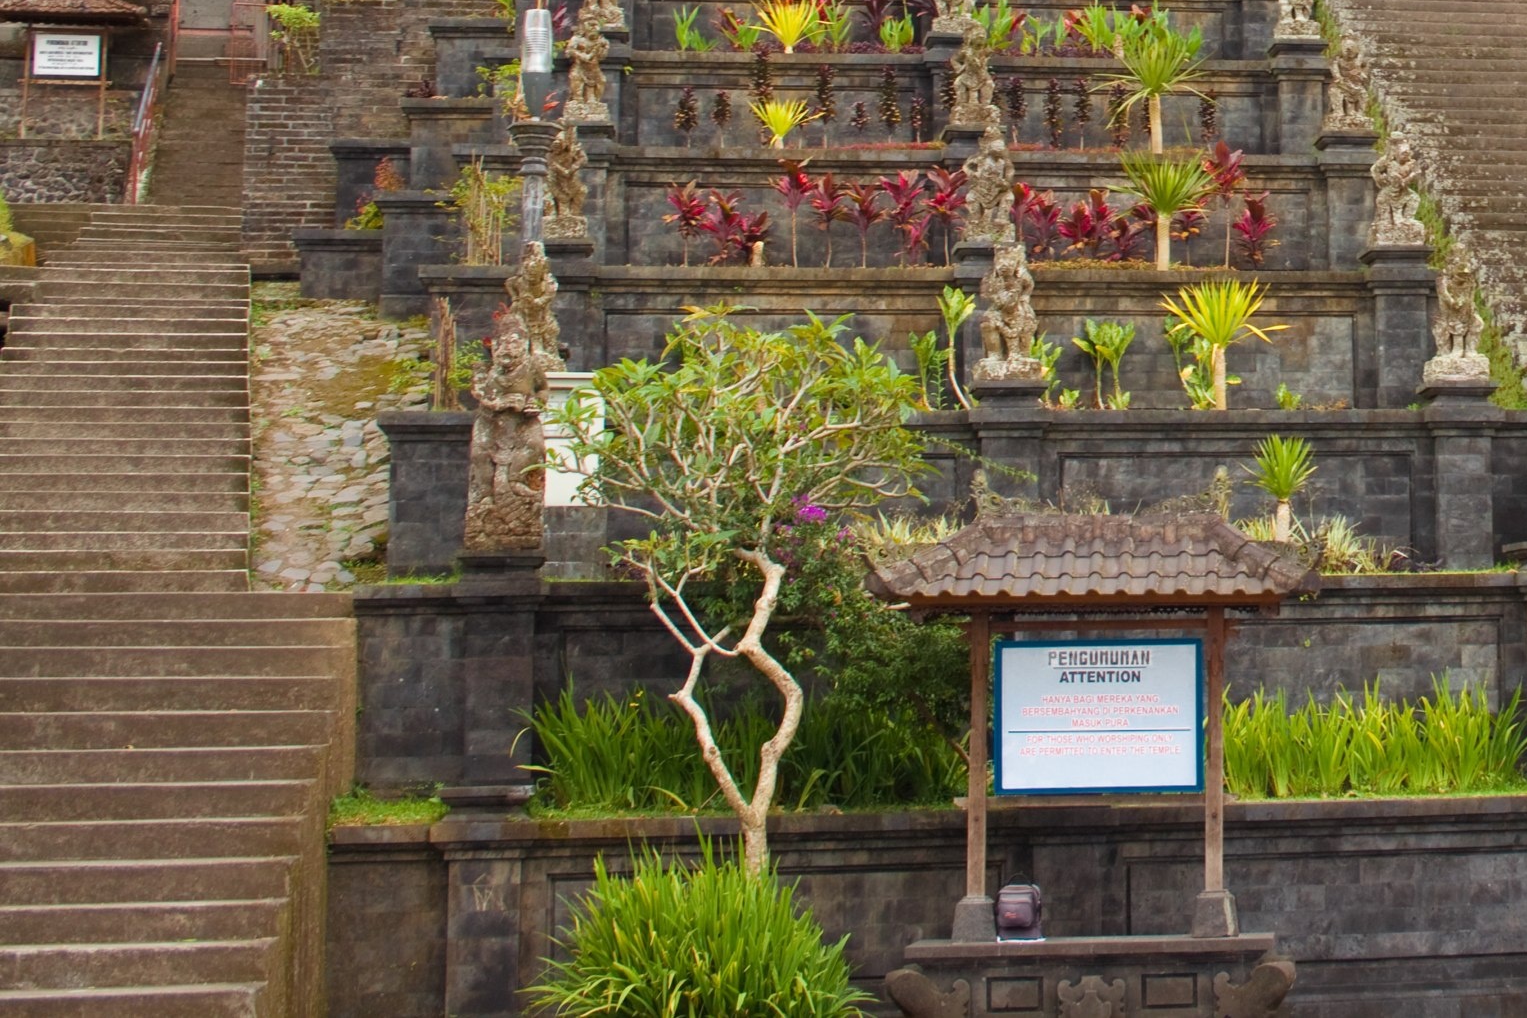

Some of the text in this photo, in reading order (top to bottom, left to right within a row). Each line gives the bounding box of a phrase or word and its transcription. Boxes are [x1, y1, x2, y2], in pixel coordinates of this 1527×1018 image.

[1048, 650, 1150, 666] PENGUMUMAN
[1059, 671, 1141, 683] ATTENTION
[1042, 694, 1158, 703] HANYA BAGI MEREKA YANG
[1022, 706, 1178, 716] BERSEMBAHYANG DI PERKENANKAN
[1072, 718, 1129, 727] MASUK PURA
[1027, 733, 1173, 743] FOR THOSE WHO WORSHIPING ONLY
[1020, 745, 1180, 756] ARE PERMITTED TO ENTER THE TEMPLE
